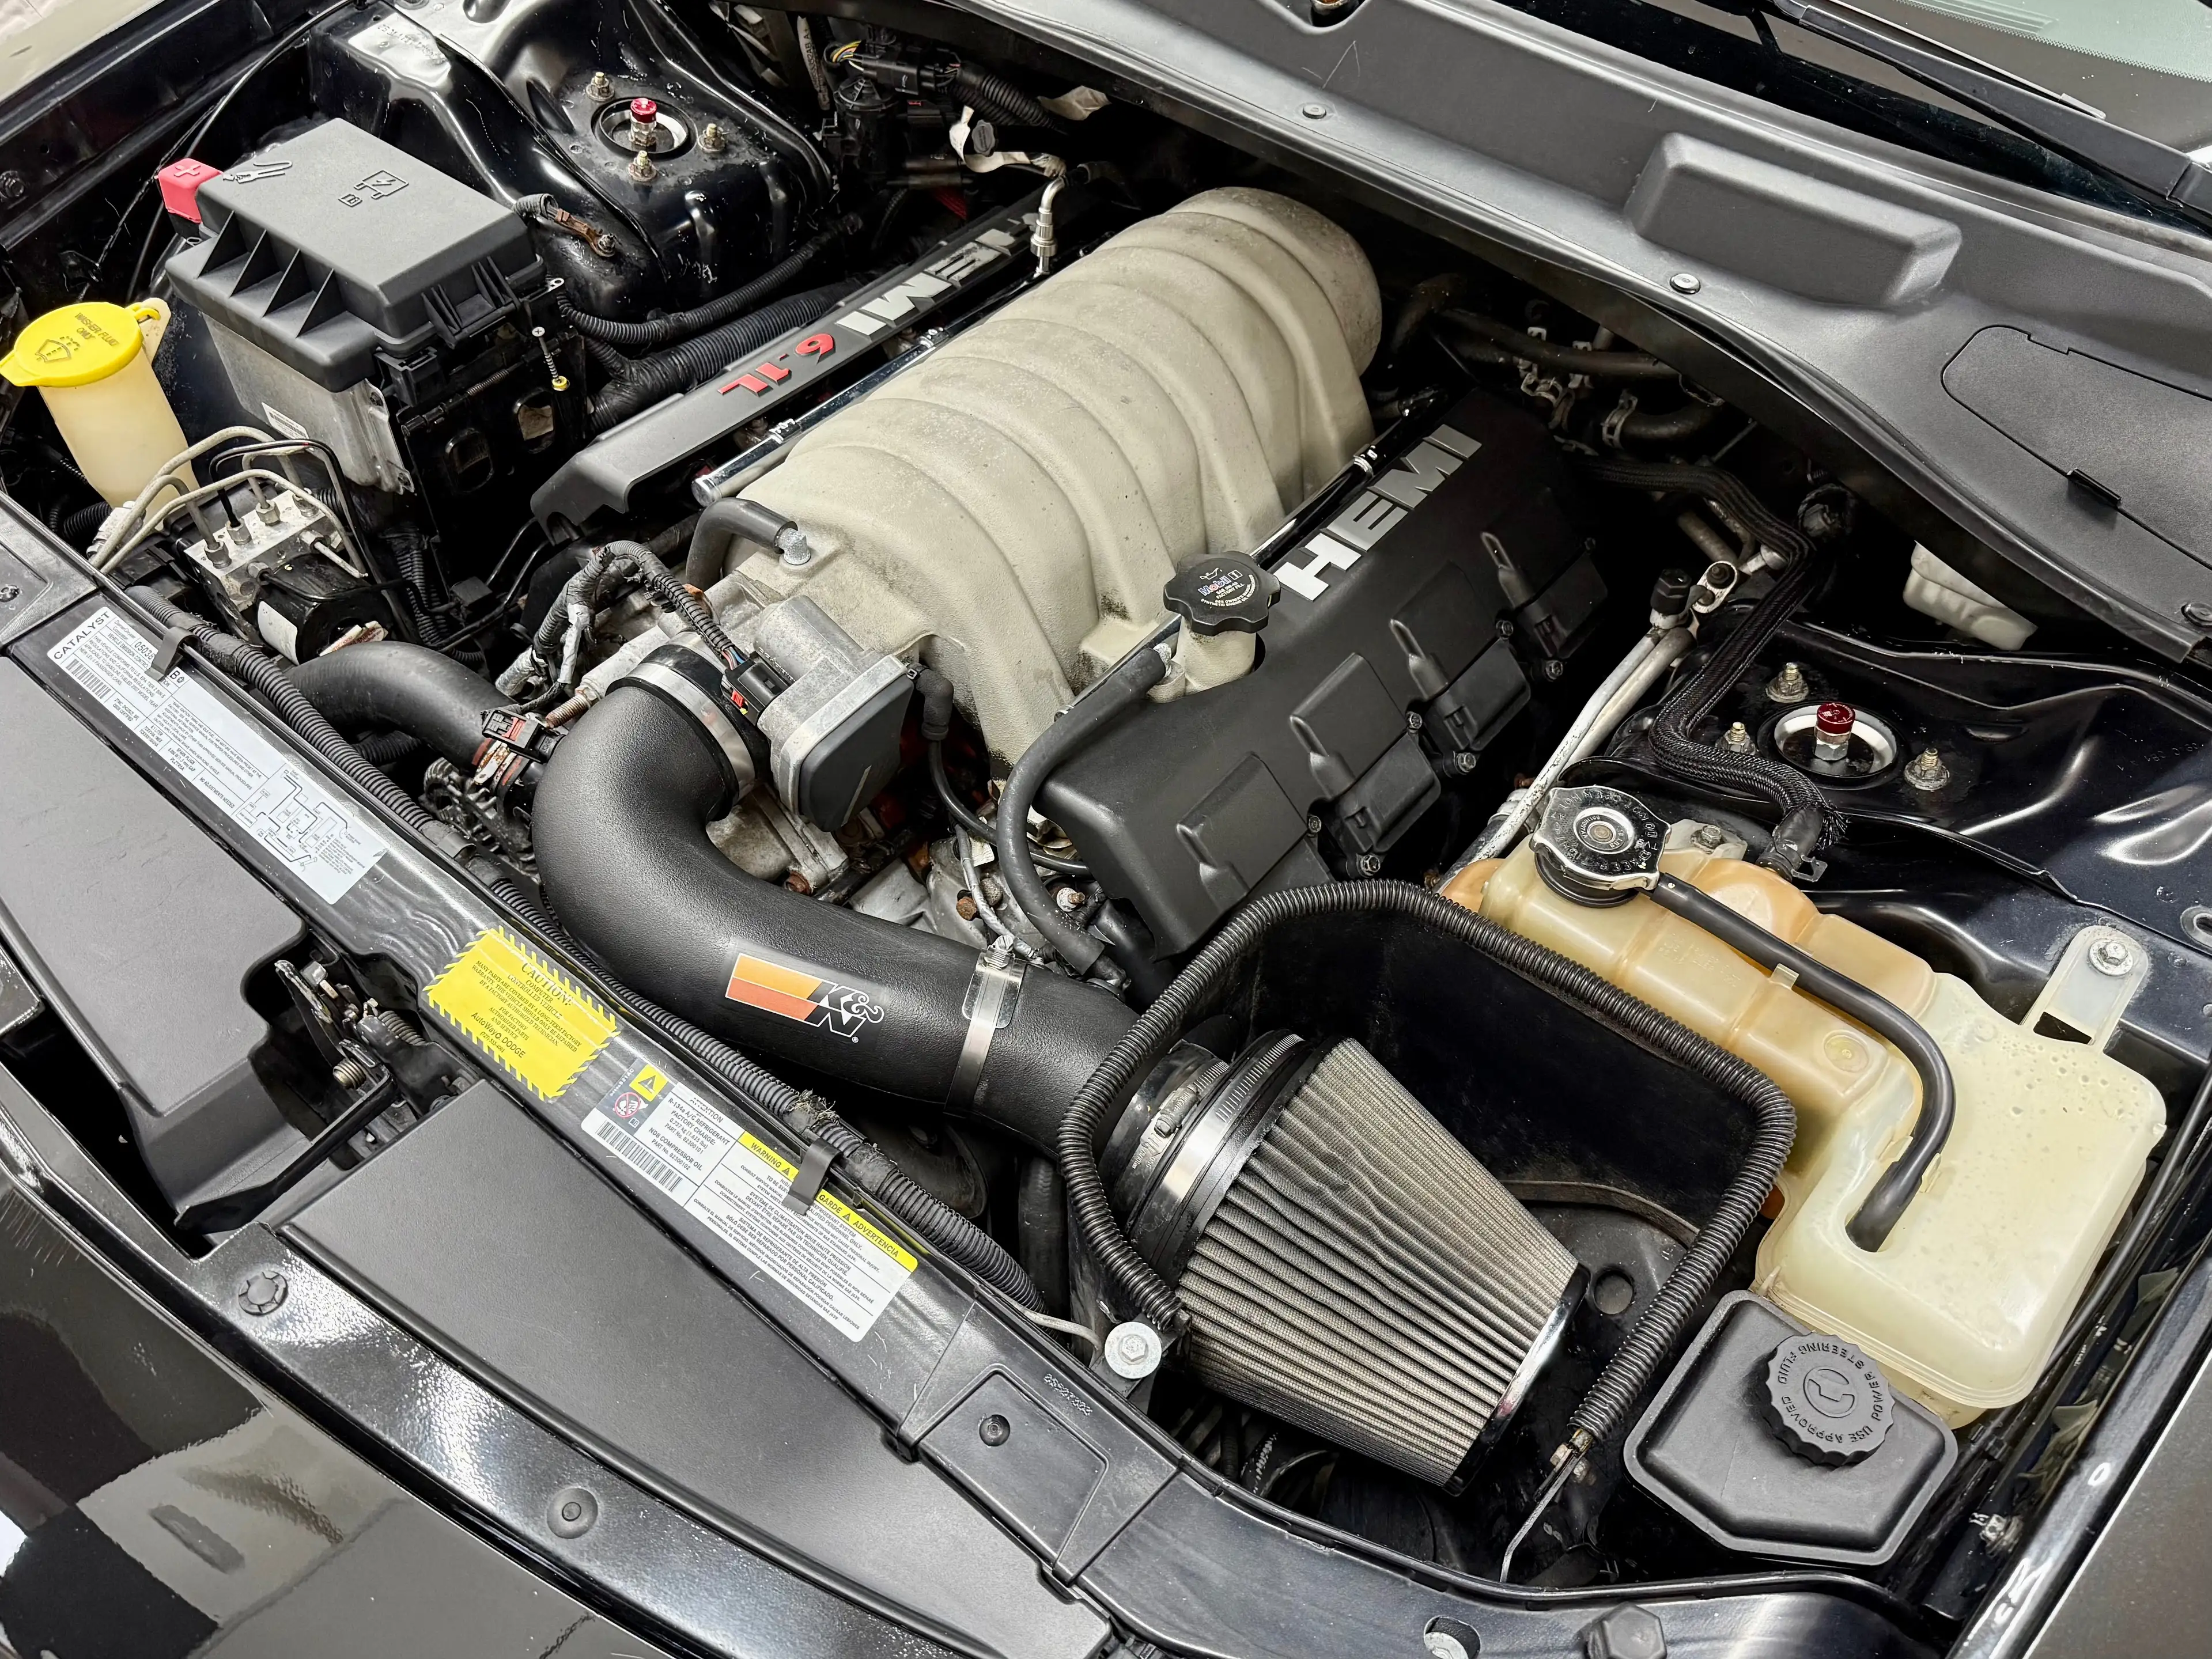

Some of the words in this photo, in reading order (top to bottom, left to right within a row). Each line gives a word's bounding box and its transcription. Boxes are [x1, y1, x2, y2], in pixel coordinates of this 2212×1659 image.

[75, 312, 101, 333] WASHER
[98, 331, 120, 346] FLUID
[77, 327, 96, 339] ONLY
[717, 333, 836, 397] 6.1L
[1273, 424, 1482, 601] HEMI
[1198, 575, 1232, 596] Mobil
[1216, 589, 1235, 599] FACTORY
[51, 611, 113, 661] CATALYST
[475, 960, 489, 972] MANY
[487, 969, 502, 983] PARTS
[500, 980, 511, 989] ARE
[508, 987, 530, 1005] COVERED
[536, 1009, 563, 1032] LONG-TERM
[561, 1029, 582, 1047] FACTORY
[506, 974, 541, 1002] CONTROLLED
[539, 999, 562, 1019] VEHICLE
[519, 962, 573, 1005] CAUTION!
[524, 979, 554, 1003] COMPUTER
[470, 964, 496, 986] WARRANTY.
[494, 983, 506, 994] THIS
[504, 991, 524, 1009] VEHICLE
[521, 1005, 540, 1022] SHOULD
[538, 1018, 551, 1031] ONLY
[555, 1032, 578, 1052] REPAIRED
[487, 987, 508, 1004] FACTORY
[506, 1002, 534, 1025] AUTHORIZED
[532, 1022, 560, 1046] TECHNICIAN.
[488, 1006, 516, 1030] AUTHORIZED
[515, 1027, 530, 1040] PARTS
[490, 1017, 501, 1026] AND
[499, 1024, 519, 1039] SERVICE
[498, 1006, 509, 1016] FOR
[507, 1013, 528, 1031] FACTORY
[804, 981, 884, 1037] K&N
[500, 1036, 525, 1058] DODGE
[667, 1098, 686, 1113] R-134a
[684, 1111, 696, 1121] A/C
[694, 1118, 730, 1146] REFRIGERANT
[671, 1109, 694, 1128] FACTORY
[659, 1135, 694, 1164] COMPRESSOR
[692, 1161, 704, 1171] OIL
[750, 1142, 782, 1168] WARNING
[778, 1184, 789, 1194] SERV
[744, 1195, 762, 1210] DEVANT
[761, 1207, 773, 1218] ÊTRE
[771, 1215, 788, 1229] RÉPARÉ
[787, 1227, 797, 1236] PAR
[795, 1233, 803, 1241] UN
[801, 1238, 828, 1260] TECHNICIEN
[826, 1257, 849, 1276] QUALIFIÉ.
[749, 1191, 769, 1207] SYSTÈME
[773, 1209, 805, 1235] CLIMATISATION
[804, 1232, 817, 1244] SOUS
[815, 1241, 831, 1255] HAUTE
[829, 1252, 852, 1270] PRESSION
[807, 1207, 826, 1222] ALIFIED
[824, 1220, 850, 1241] PERSONNEL
[849, 1238, 863, 1250] ONLY.
[818, 1194, 842, 1214] GARDE
[852, 1219, 901, 1257] ADVERTENCIA
[725, 1214, 738, 1225] SÓLO
[736, 1222, 748, 1234] DEBE
[747, 1231, 757, 1240] SER
[755, 1237, 778, 1257] REPARADO
[777, 1254, 787, 1264] POR
[785, 1261, 809, 1281] PERSONAL
[807, 1278, 835, 1301] CALIFICADO.
[738, 1217, 757, 1233] SISTEMA
[762, 1235, 793, 1260] REFRIGERANTE
[797, 1263, 810, 1273] ALTA
[808, 1270, 828, 1287] PRESIÓN
[1778, 1351, 1798, 1384] FLUID
[1798, 1342, 1865, 1369] STEERING
[1863, 1371, 1884, 1421] POWER
[1781, 1396, 1843, 1443] APPROVED
[1848, 1425, 1873, 1442] USE
